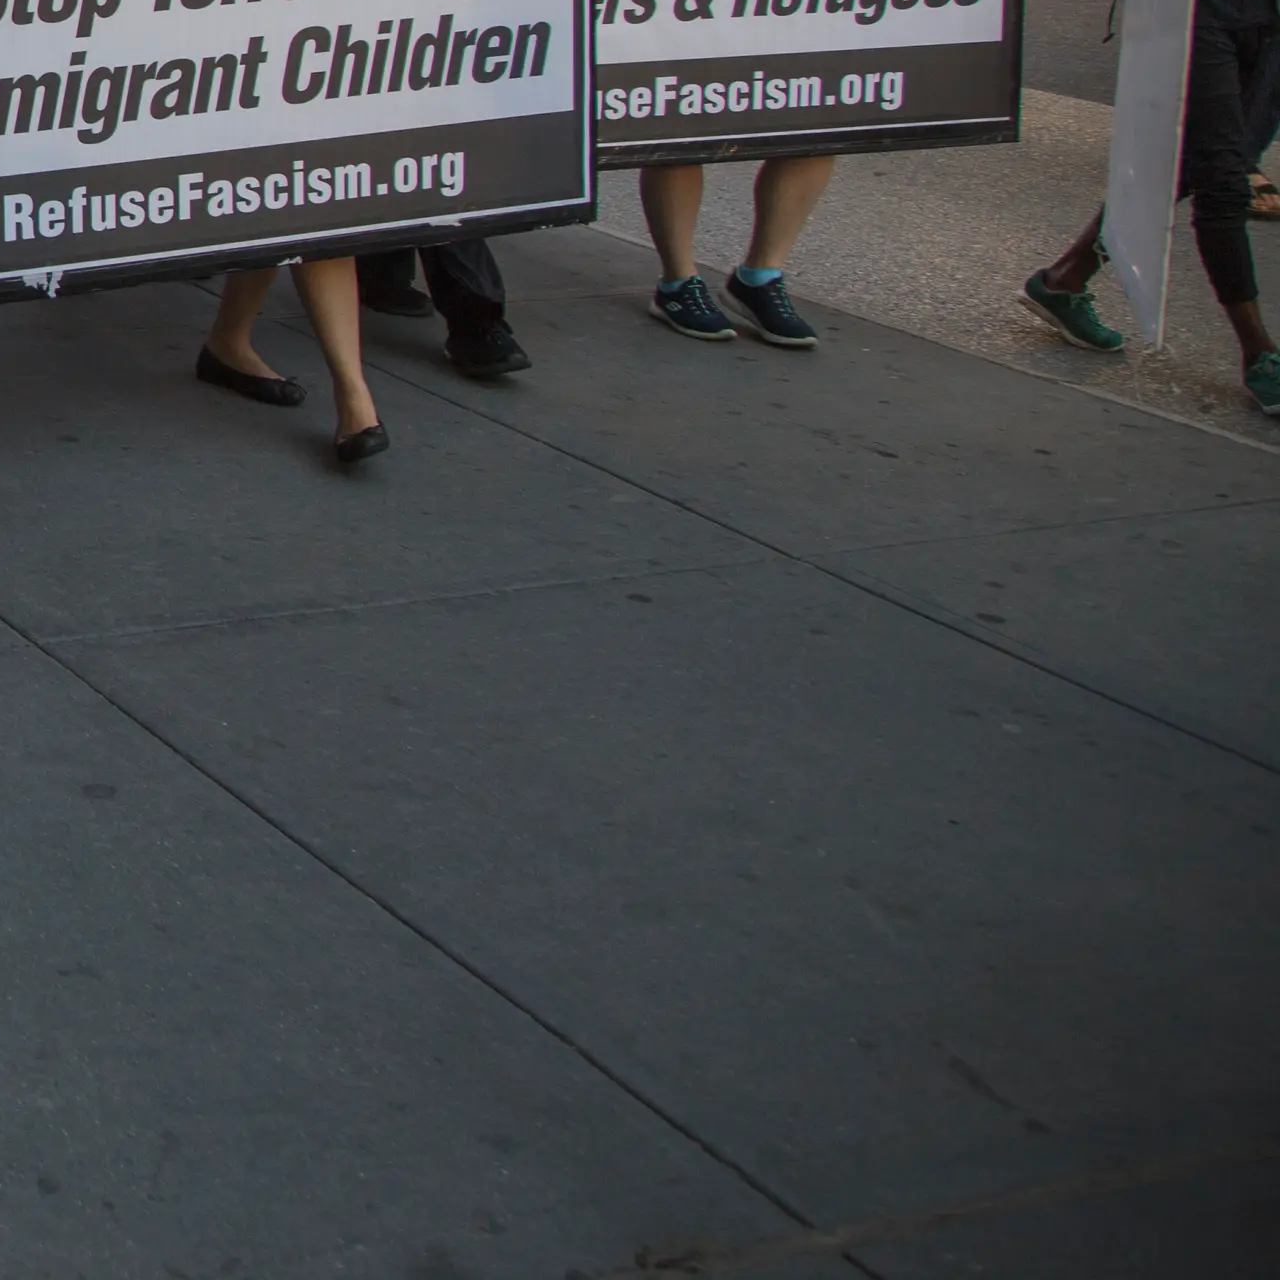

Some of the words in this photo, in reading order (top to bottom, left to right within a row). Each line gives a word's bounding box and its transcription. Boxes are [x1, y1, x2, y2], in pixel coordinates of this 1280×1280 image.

[281, 15, 551, 104] Children
[596, 69, 905, 121] seFascism.org
[2, 149, 466, 243] RefuseFascism.org
